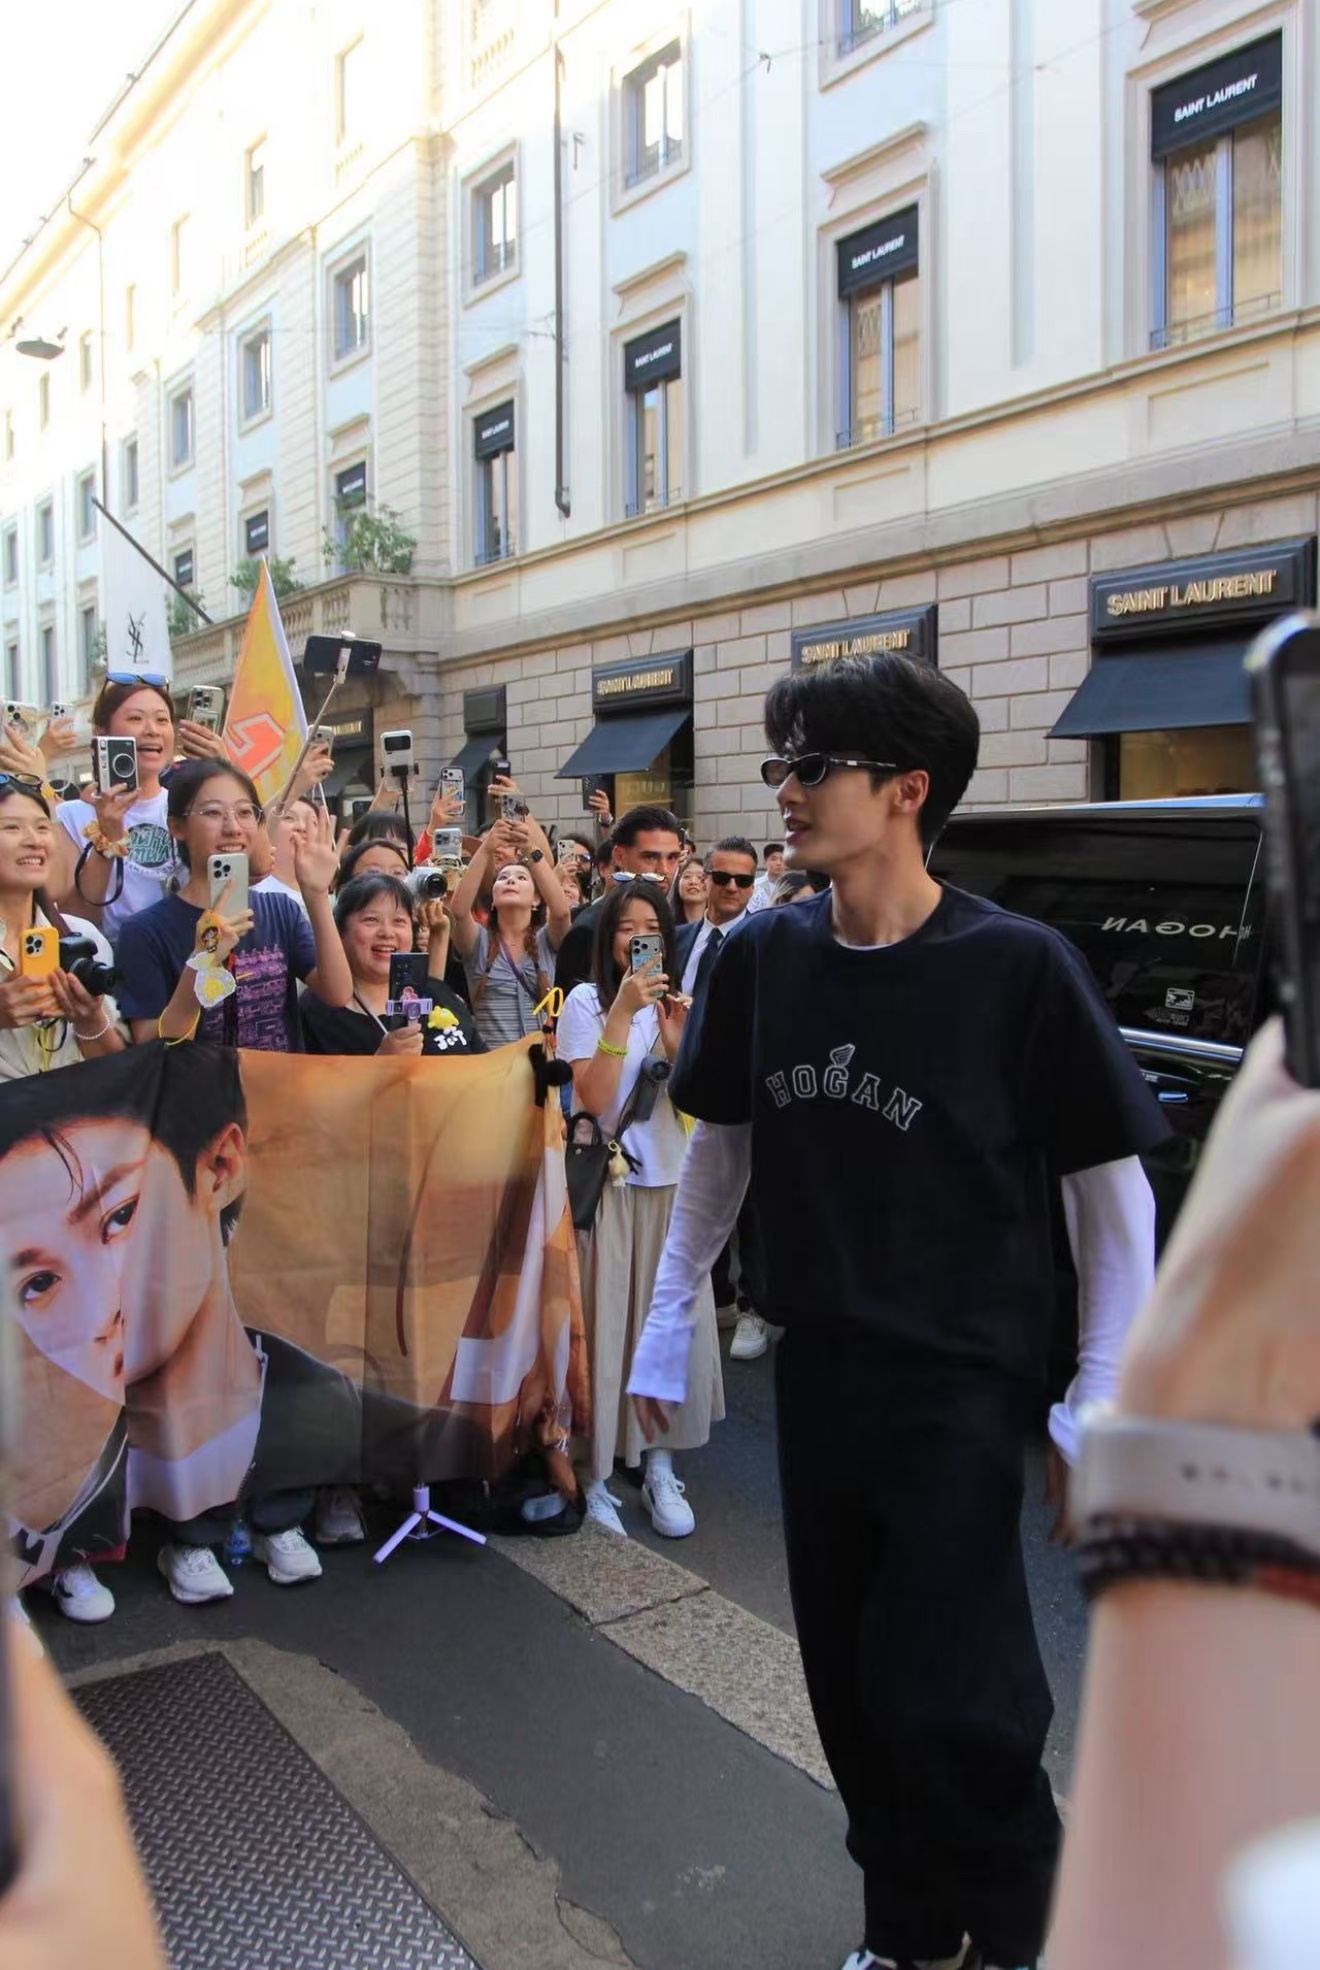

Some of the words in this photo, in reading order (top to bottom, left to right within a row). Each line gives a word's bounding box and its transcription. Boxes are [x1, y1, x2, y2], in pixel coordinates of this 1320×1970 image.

[1174, 97, 1206, 122] SAINT
[1206, 73, 1258, 108] LAURENT
[1107, 587, 1168, 616] SAINT
[1170, 569, 1277, 606] LAURENT
[801, 642, 840, 664] SAINT
[765, 1065, 923, 1131] HOGAN
